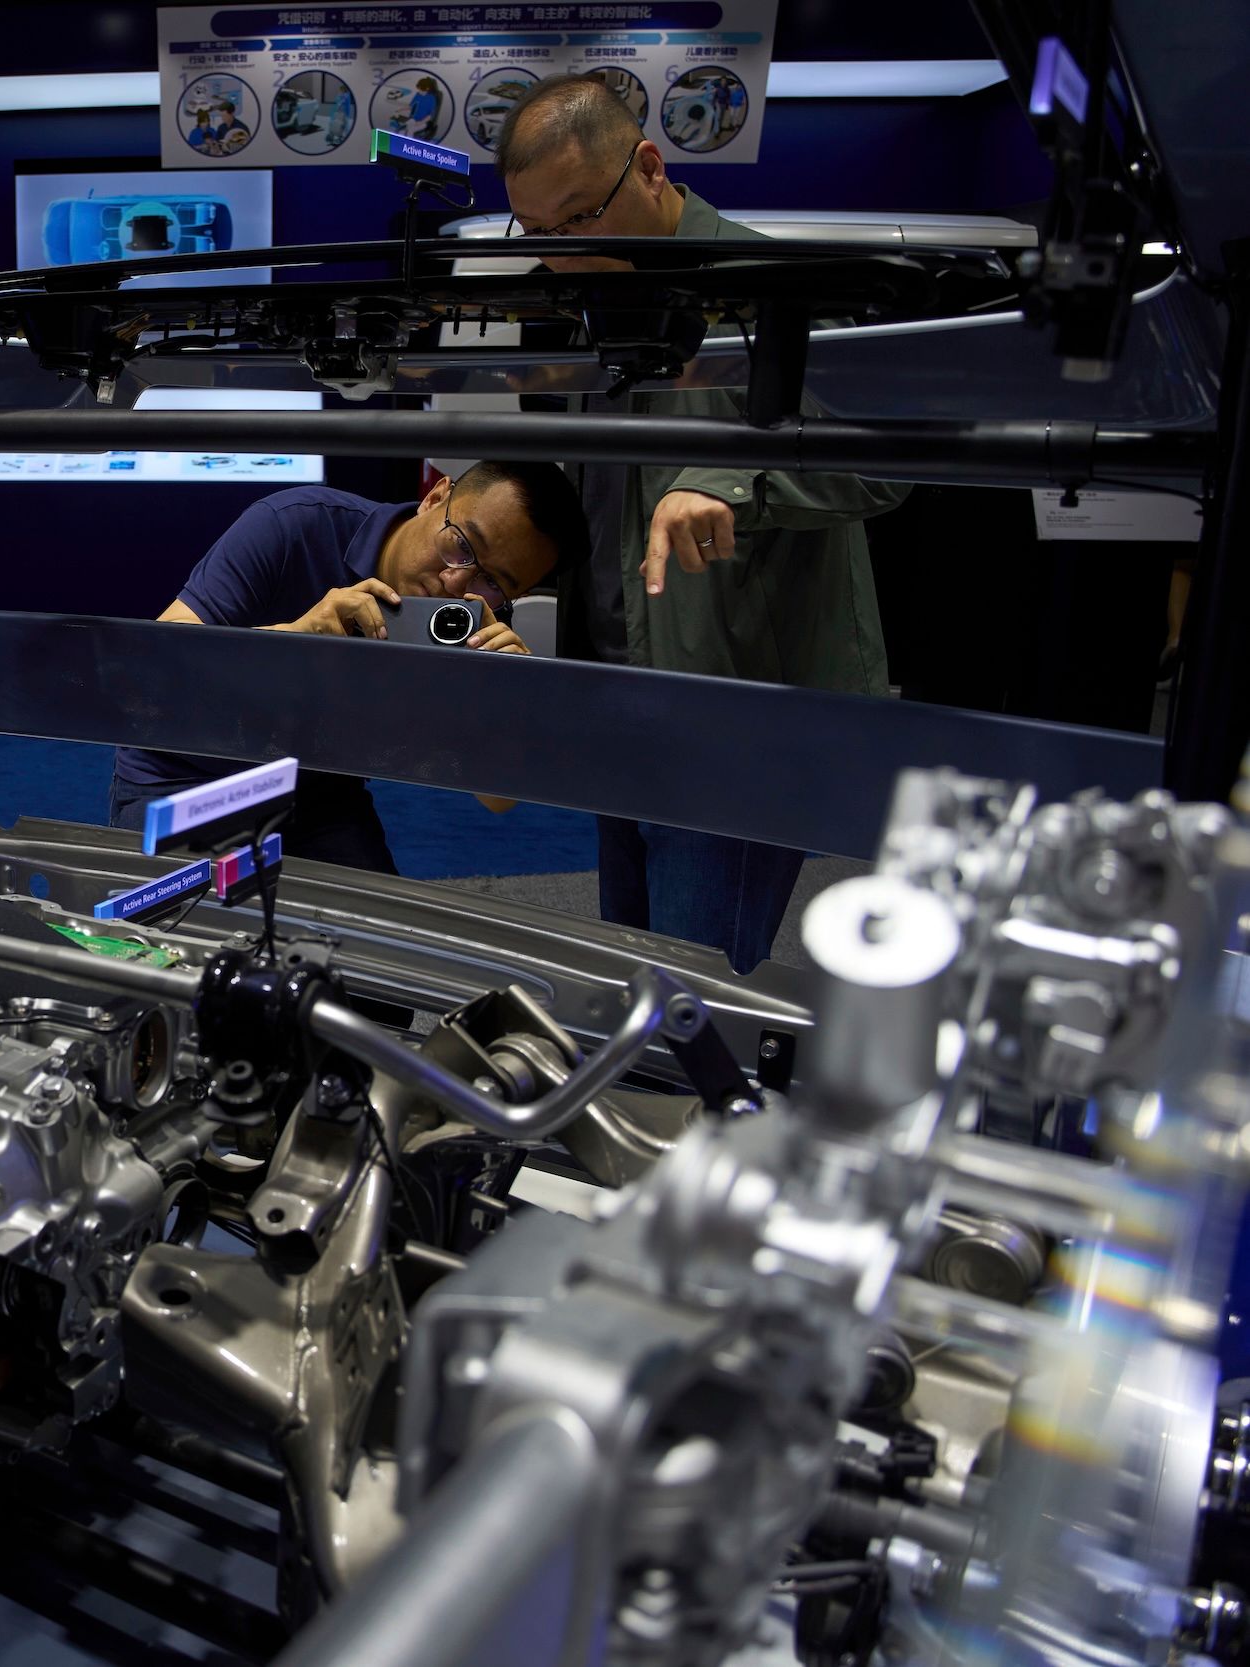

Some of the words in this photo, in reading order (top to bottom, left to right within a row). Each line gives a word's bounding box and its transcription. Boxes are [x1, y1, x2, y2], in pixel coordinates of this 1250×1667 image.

[273, 70, 285, 88] 2
[372, 68, 383, 86] 3
[469, 67, 481, 84] 4
[665, 65, 678, 84] 6
[403, 144, 421, 157] Active
[423, 148, 436, 160] Rear
[437, 153, 457, 167] Spoiler
[188, 796, 226, 819] Electronic
[228, 786, 251, 804] Active
[252, 775, 285, 797] Stabilizer
[122, 898, 142, 913] Active
[143, 892, 157, 907] Rear
[157, 881, 182, 902] Steering
[182, 870, 203, 887] System
